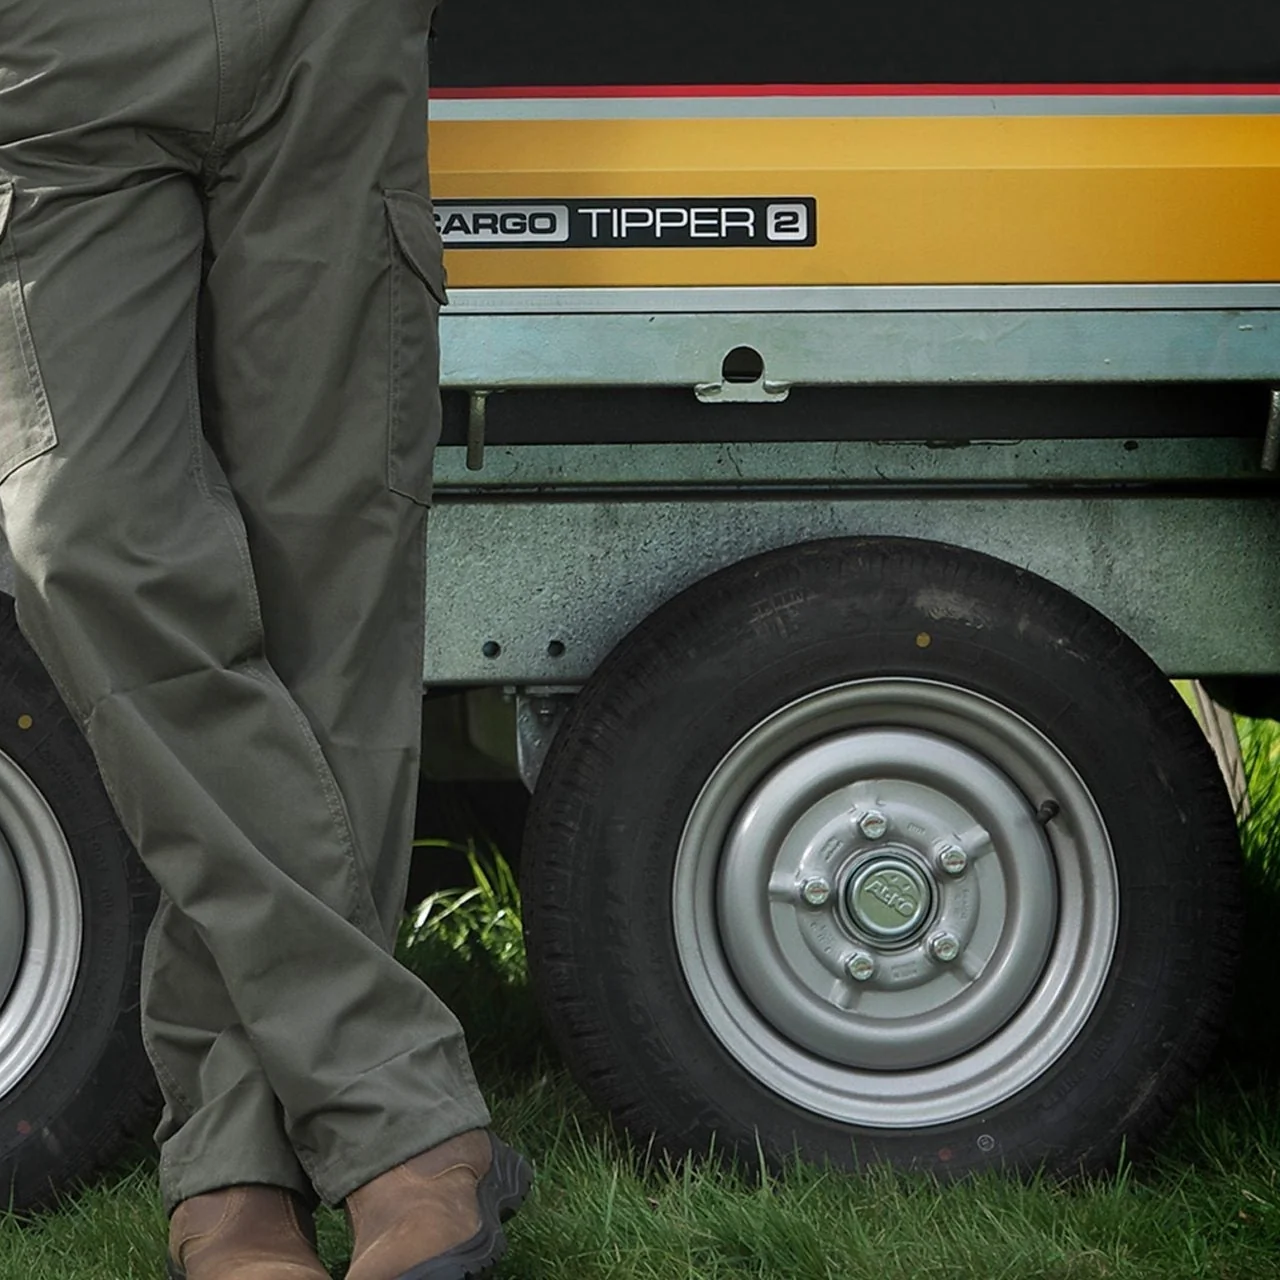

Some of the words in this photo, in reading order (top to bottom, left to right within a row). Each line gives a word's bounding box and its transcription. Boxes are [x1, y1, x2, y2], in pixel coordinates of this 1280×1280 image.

[433, 213, 557, 235] ARGO
[577, 208, 755, 238] TIPPER
[773, 211, 800, 233] 2
